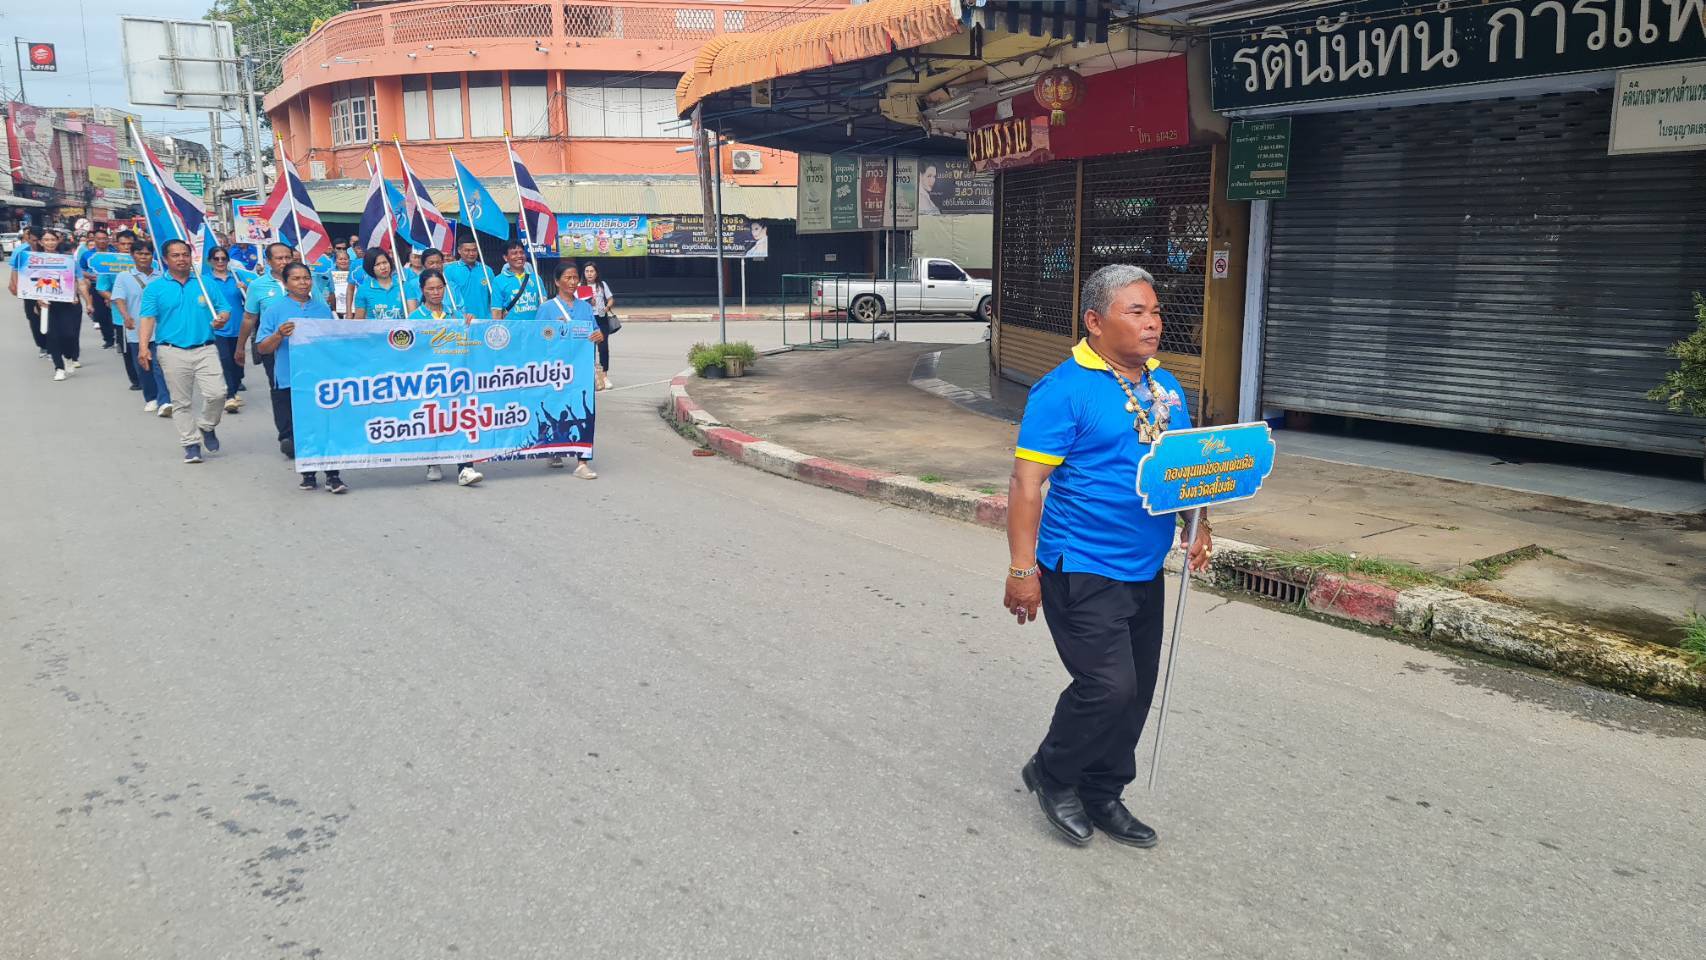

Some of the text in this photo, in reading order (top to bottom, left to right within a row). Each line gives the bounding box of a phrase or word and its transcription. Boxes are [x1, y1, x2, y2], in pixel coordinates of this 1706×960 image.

[318, 362, 572, 405] ยาเสพติด แค่คิดไปยุ่ง
[368, 398, 528, 442] ชีวิตก็ไม่รุ่งแล้ว
[1163, 454, 1255, 483] กองทุนแม่ของแผ่นดิน
[1178, 476, 1236, 500] จังหวัดสุโขทัย
